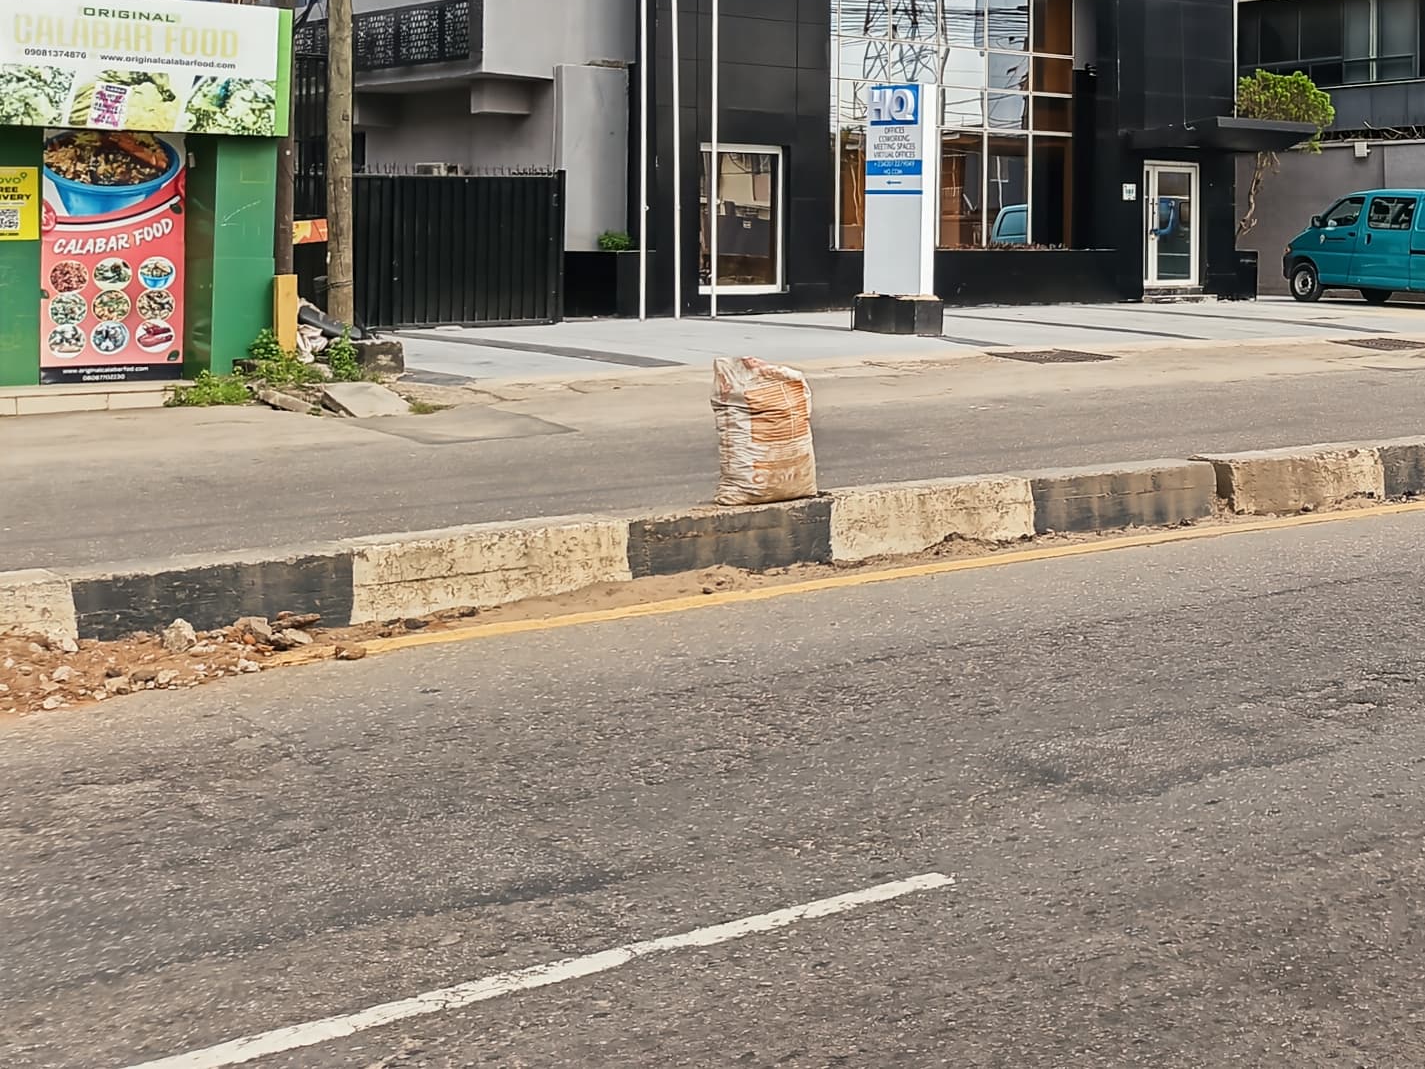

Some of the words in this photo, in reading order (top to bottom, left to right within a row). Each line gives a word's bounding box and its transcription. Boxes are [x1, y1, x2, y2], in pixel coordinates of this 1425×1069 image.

[83, 7, 176, 23] ORIGINAL
[14, 14, 153, 52] CALABAR
[164, 27, 239, 58] FOOD
[100, 53, 236, 70] www.originalcalabarfood.com
[869, 88, 915, 121] HQ
[896, 142, 916, 150] SPACES
[53, 233, 131, 256] CALABAR
[132, 218, 174, 247] FOOD
